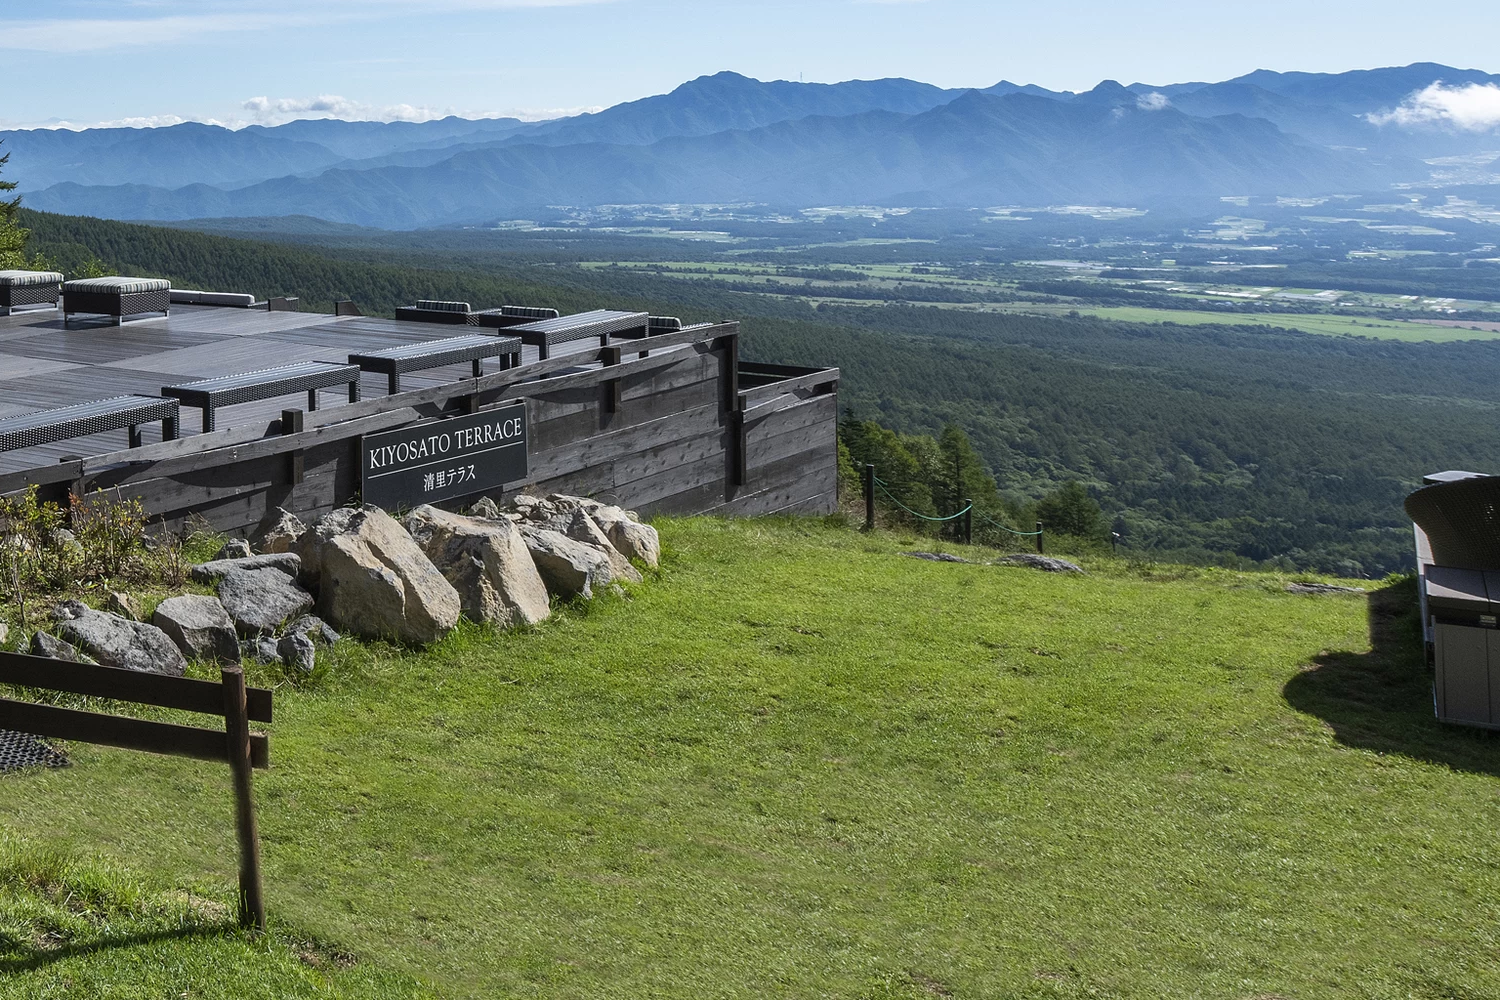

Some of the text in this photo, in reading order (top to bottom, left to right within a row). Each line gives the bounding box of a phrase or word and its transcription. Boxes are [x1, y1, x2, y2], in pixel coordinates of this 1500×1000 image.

[369, 417, 523, 470] KIYOSATO TERRACE
[423, 464, 476, 492] 清里テラス
